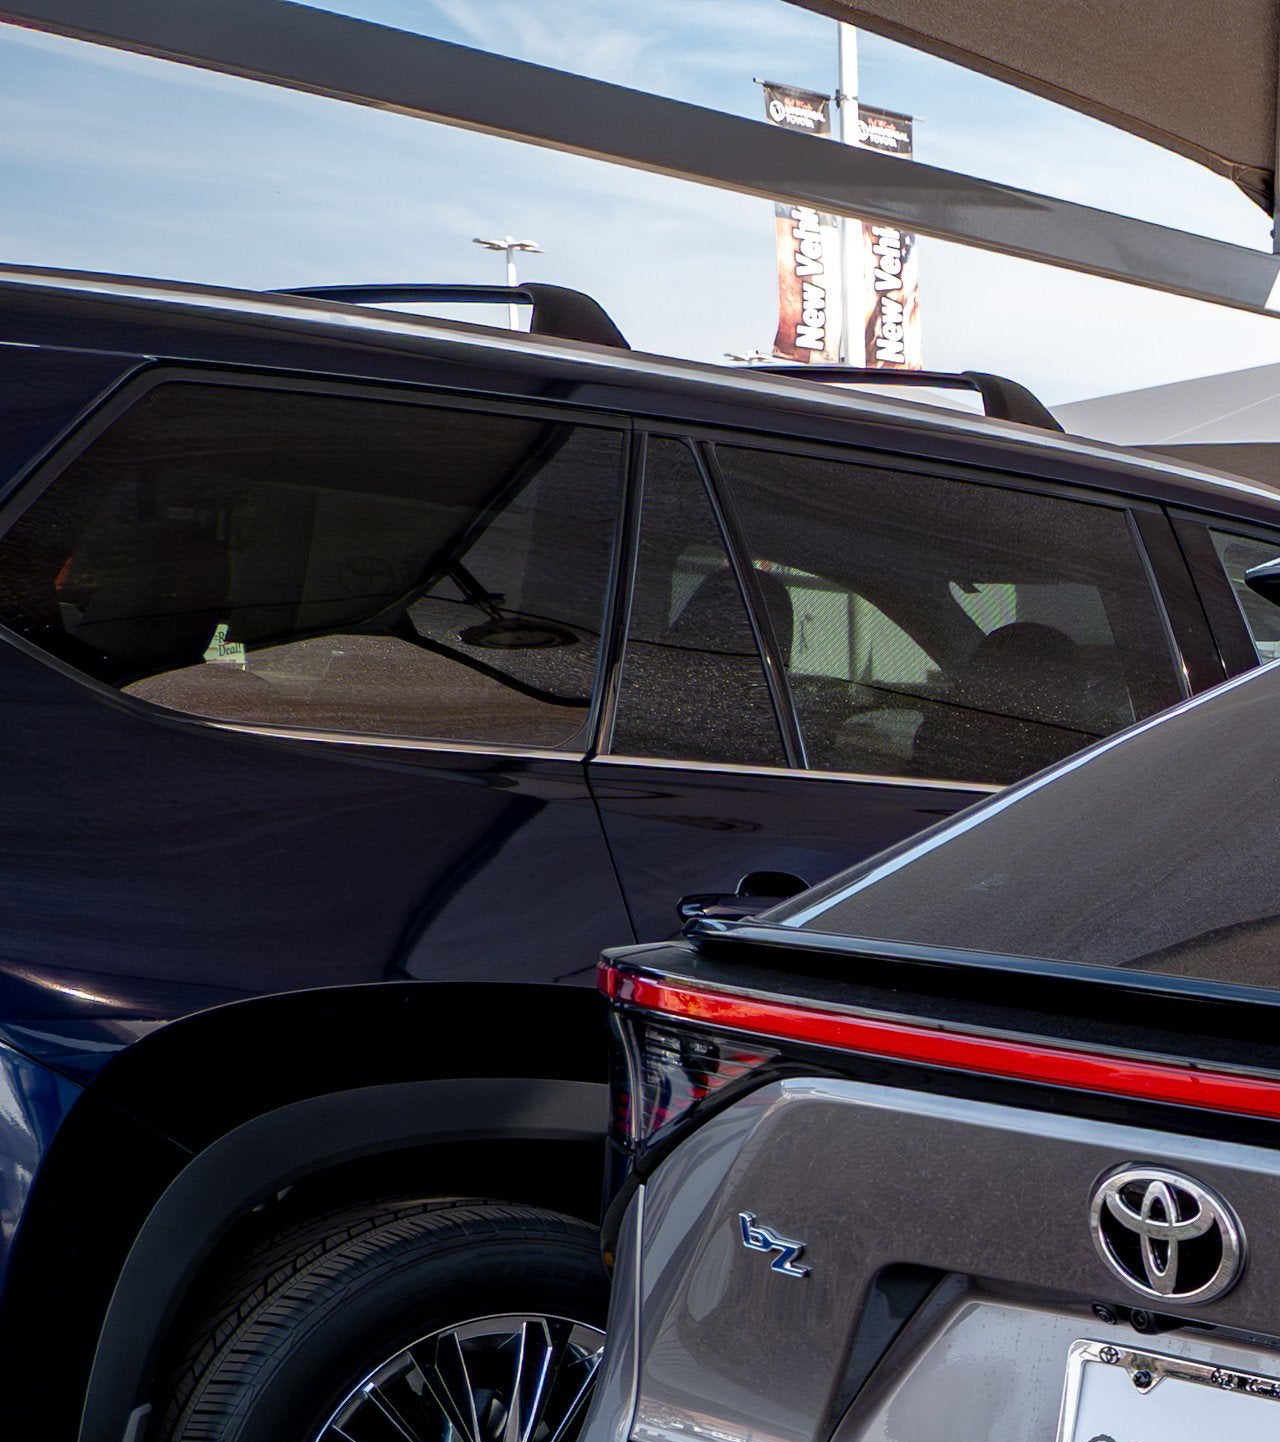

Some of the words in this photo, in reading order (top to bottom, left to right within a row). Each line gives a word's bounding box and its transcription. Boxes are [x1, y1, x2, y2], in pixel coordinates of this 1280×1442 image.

[796, 281, 826, 351] New
[875, 296, 905, 364] New
[219, 642, 241, 656] Deal!
